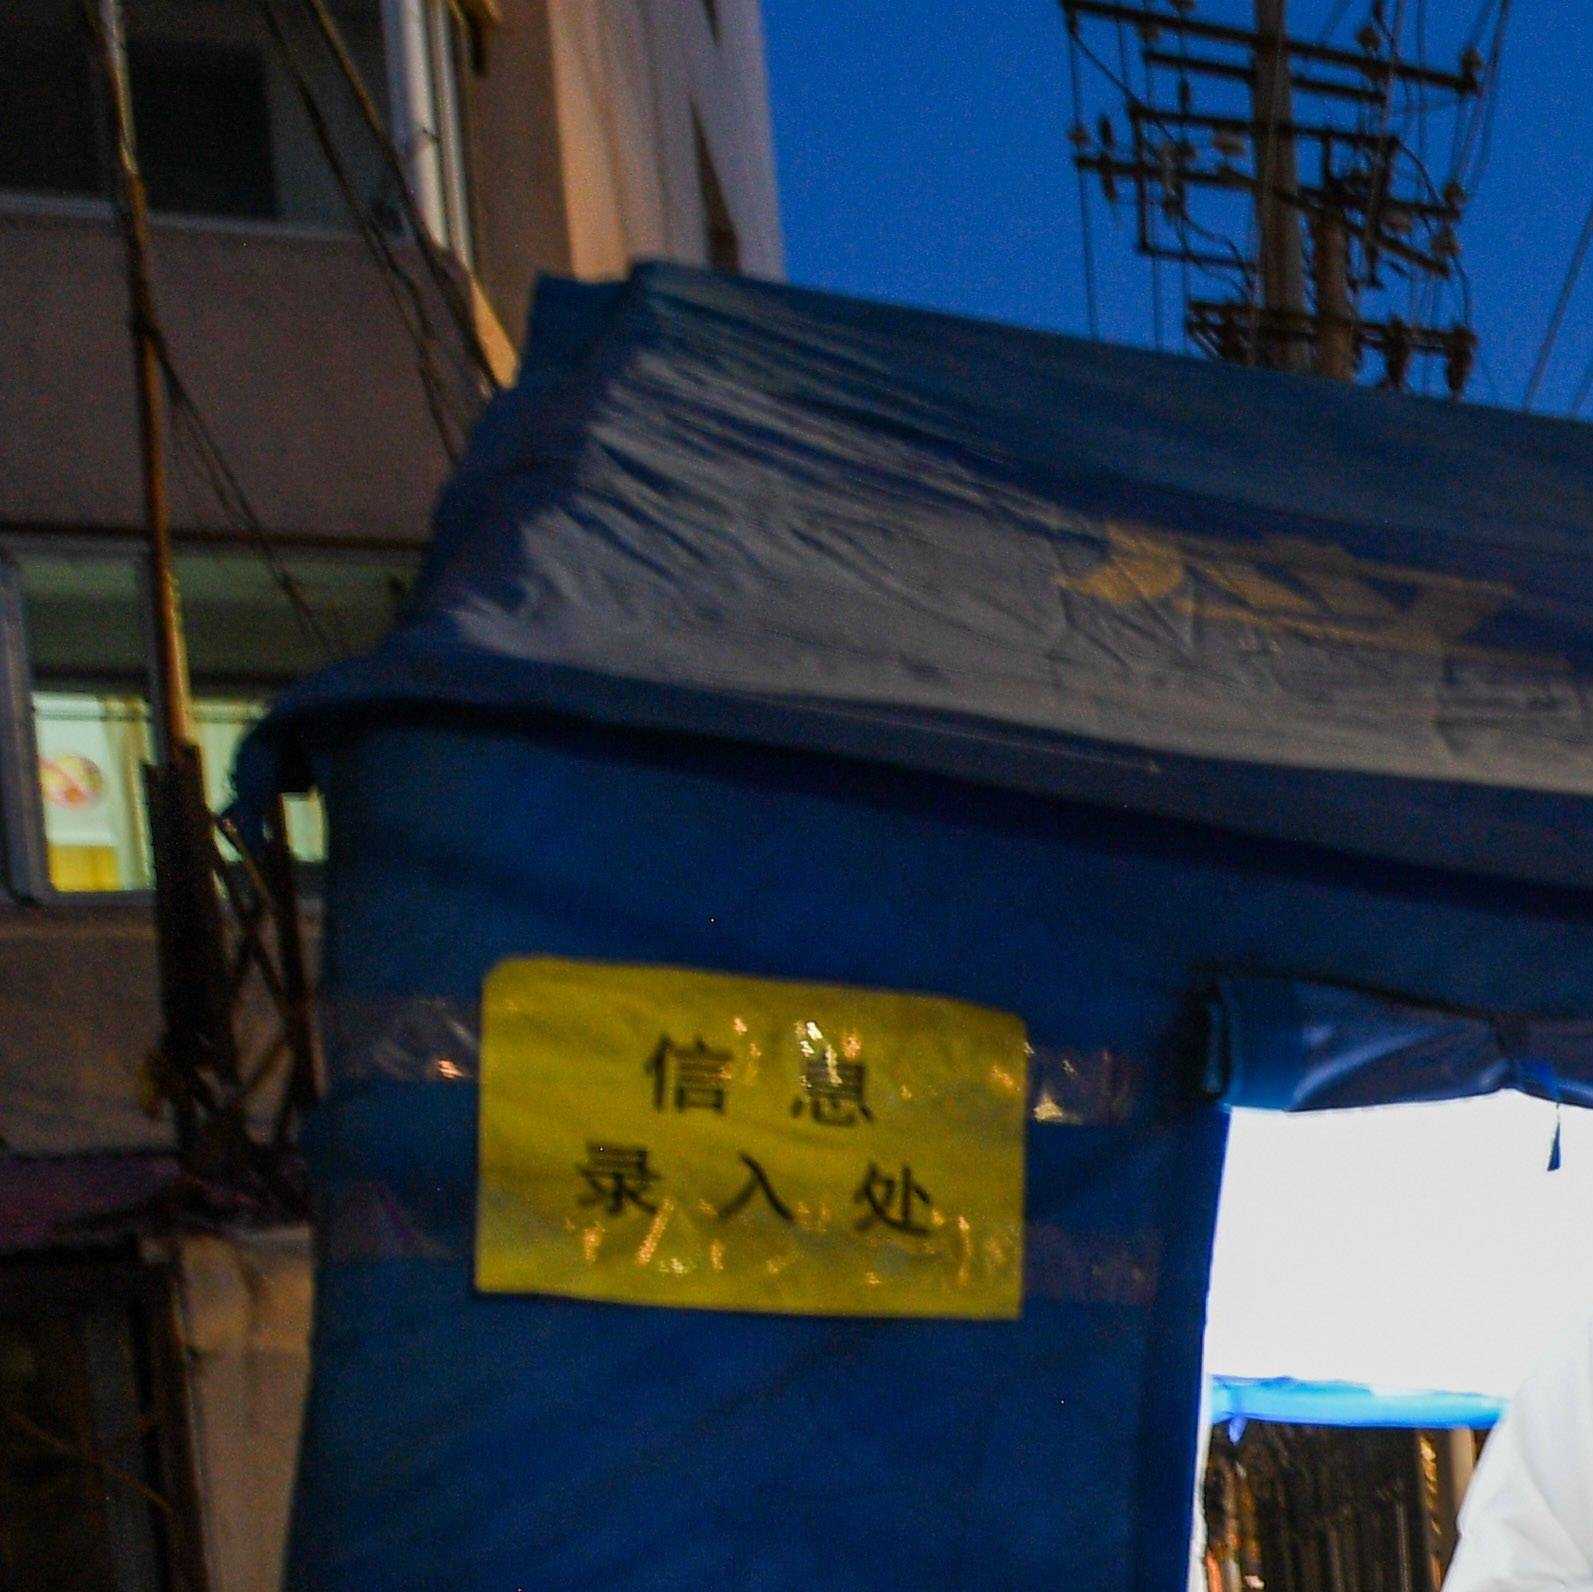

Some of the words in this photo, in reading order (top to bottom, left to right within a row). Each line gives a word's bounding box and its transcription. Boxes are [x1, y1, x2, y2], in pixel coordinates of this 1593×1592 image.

[644, 1032, 876, 1128] 信息
[578, 1139, 936, 1238] 录入处
